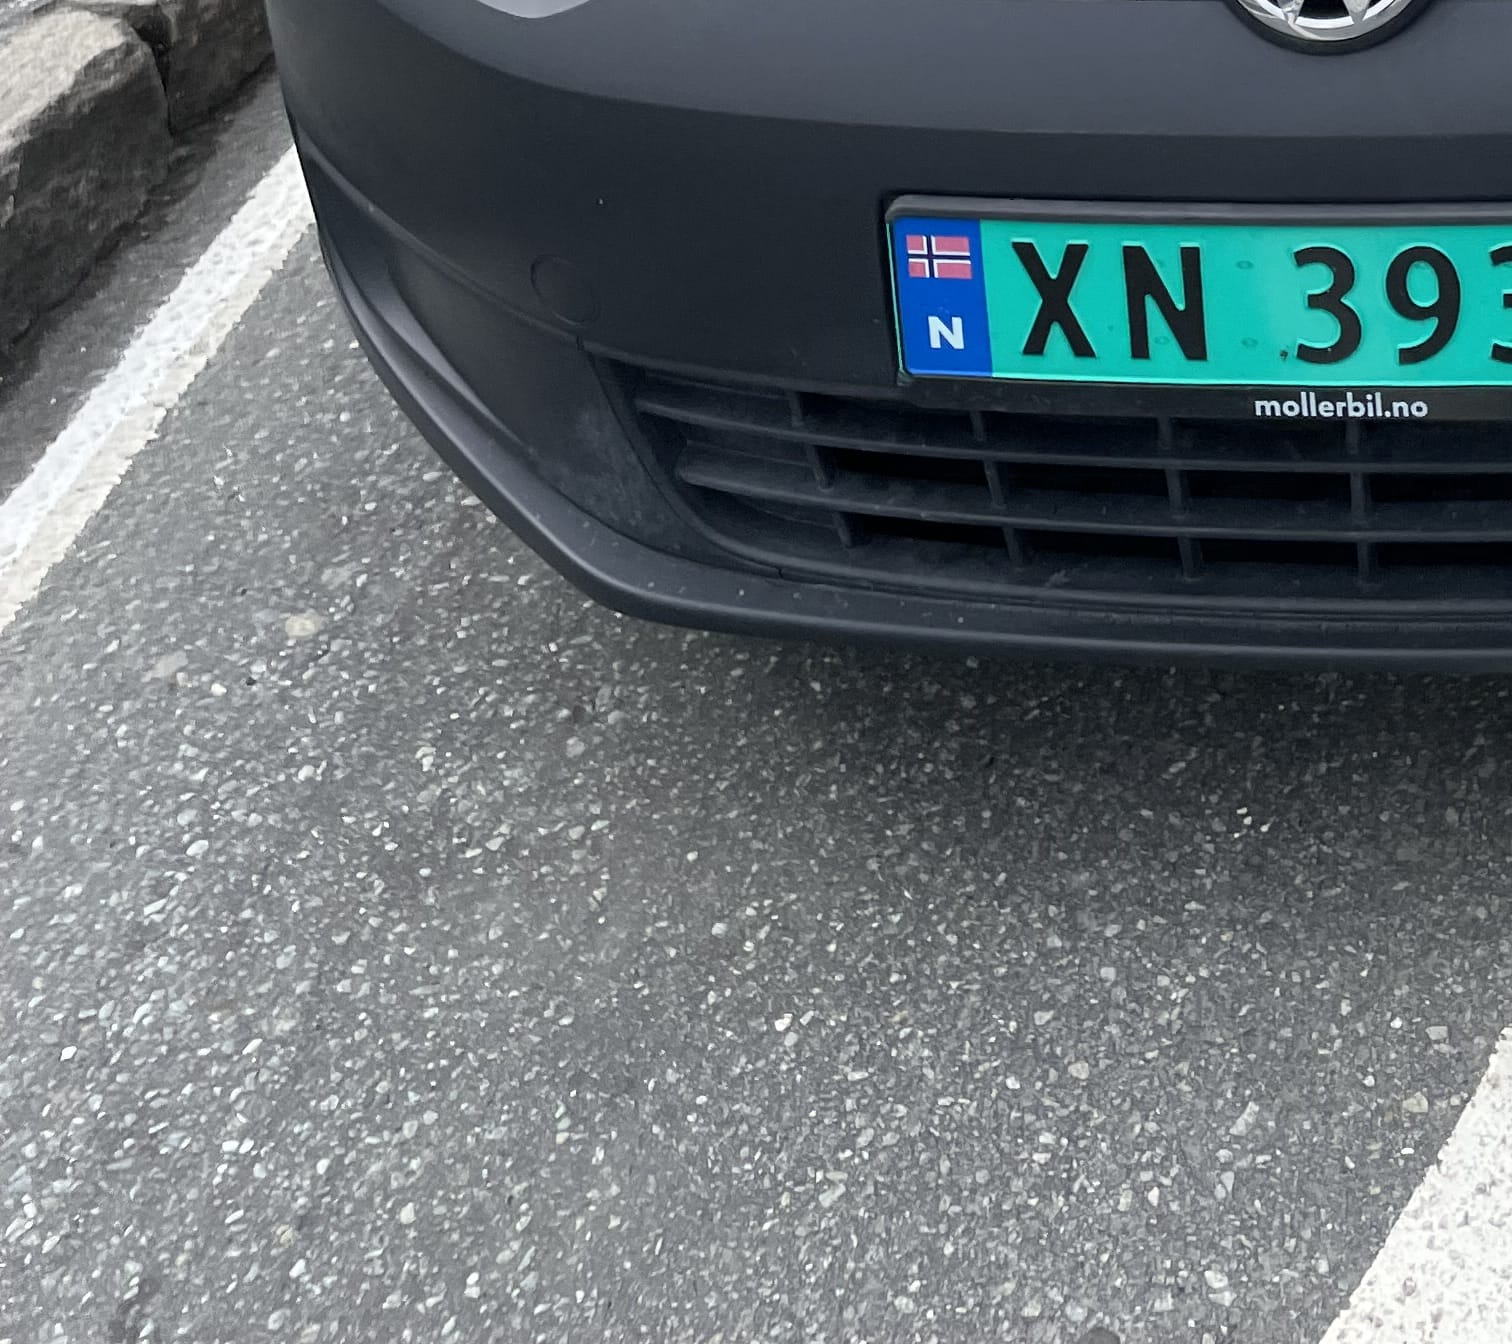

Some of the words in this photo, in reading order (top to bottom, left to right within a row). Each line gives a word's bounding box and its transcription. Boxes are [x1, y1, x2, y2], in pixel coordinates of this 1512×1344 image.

[1011, 240, 1208, 361] XN
[927, 315, 966, 350] N
[1254, 391, 1429, 419] mollerbil.no
